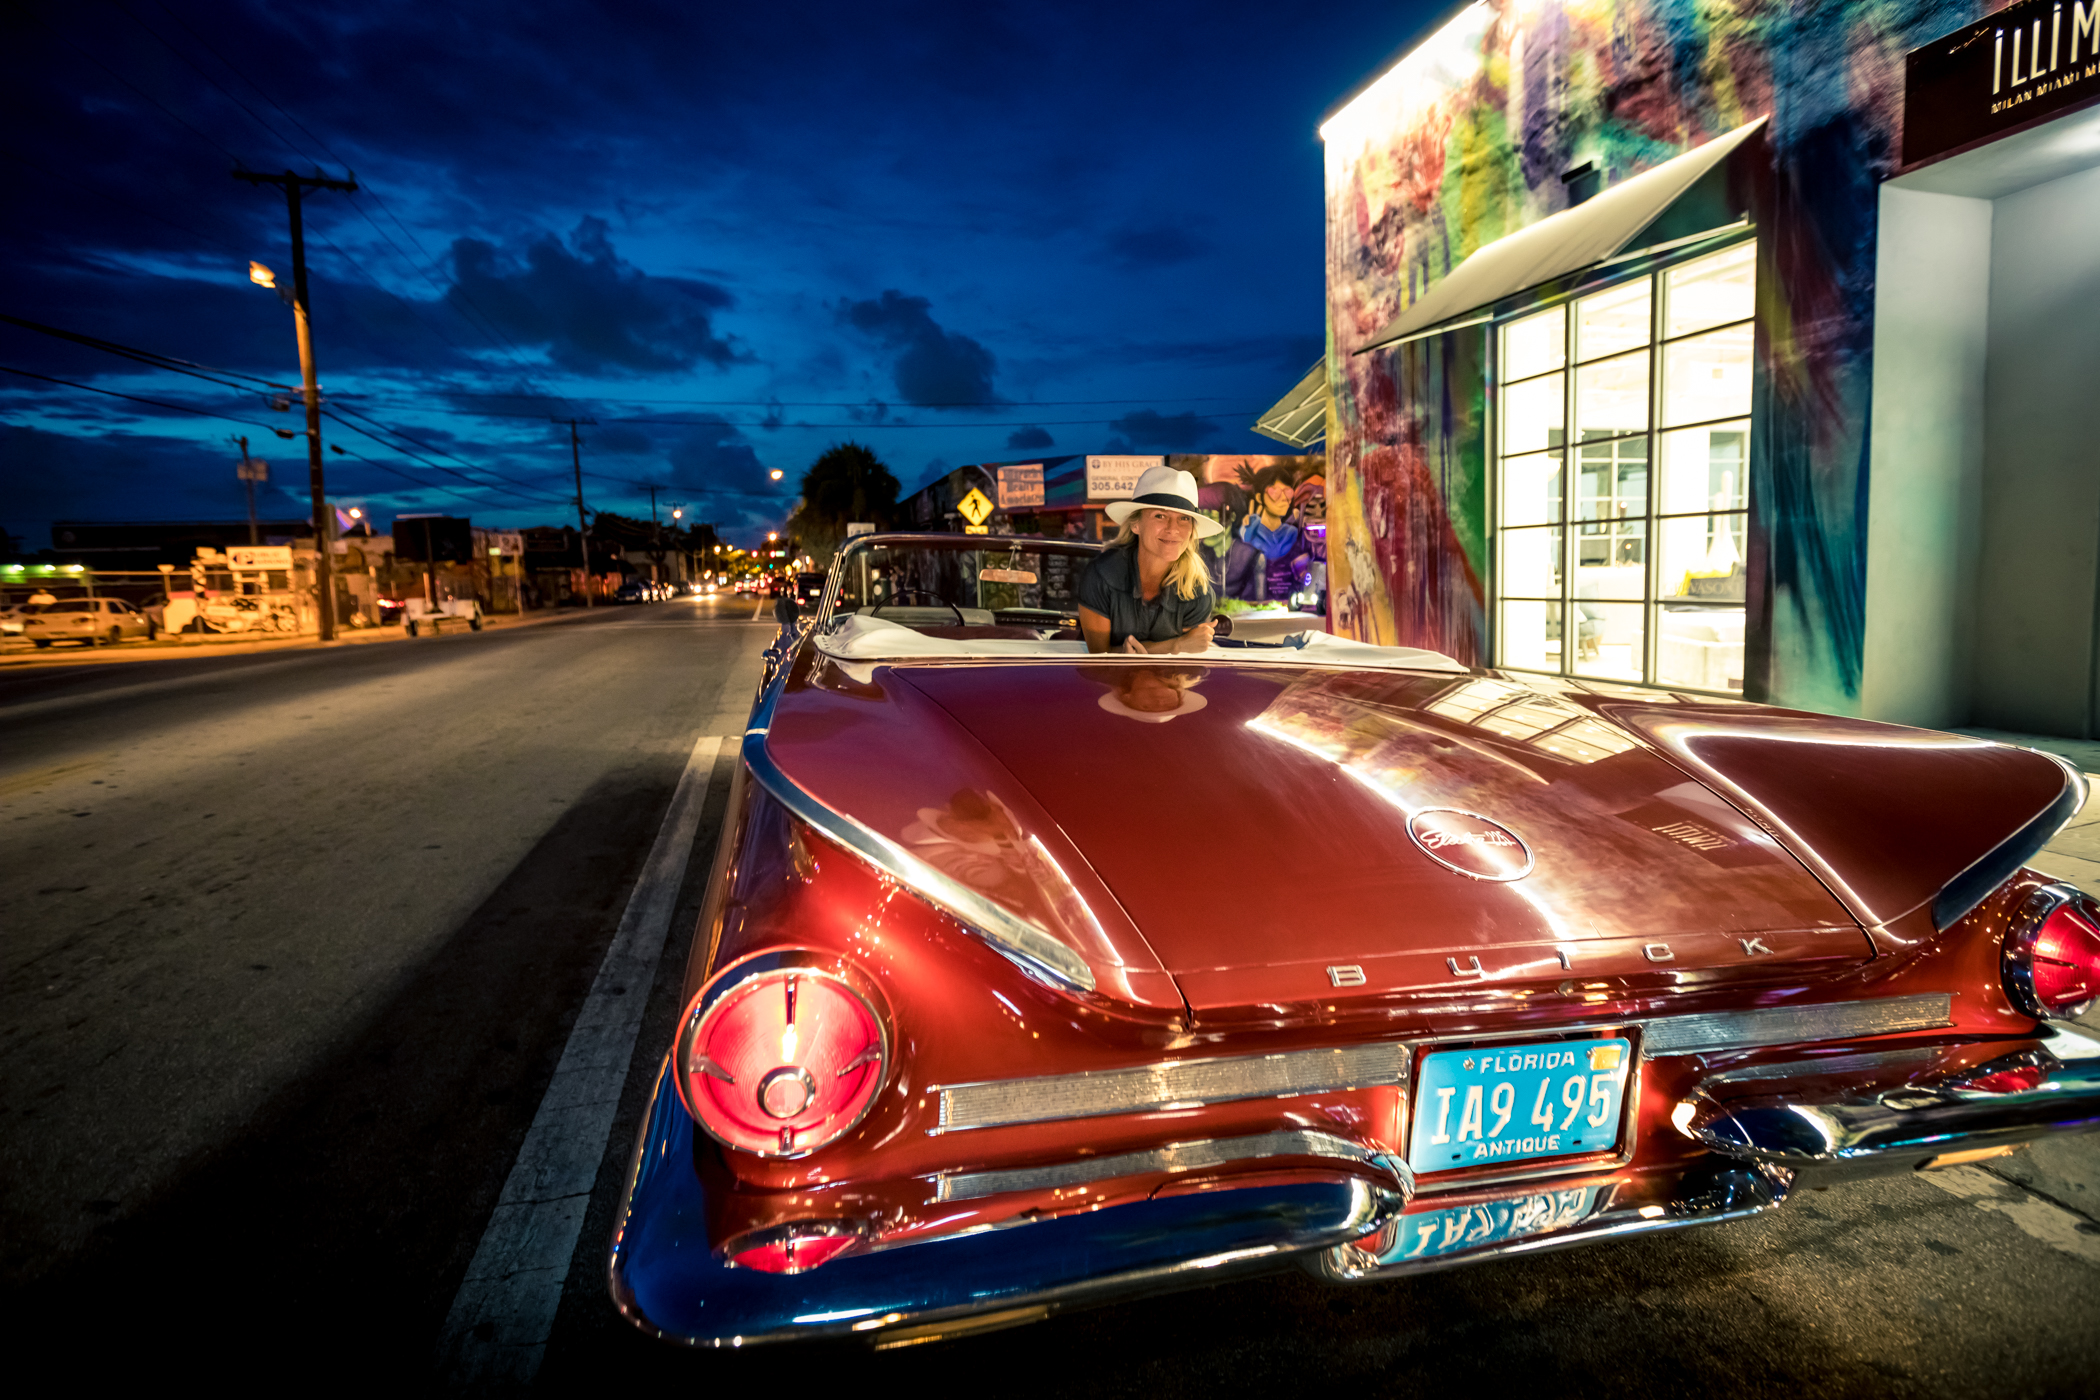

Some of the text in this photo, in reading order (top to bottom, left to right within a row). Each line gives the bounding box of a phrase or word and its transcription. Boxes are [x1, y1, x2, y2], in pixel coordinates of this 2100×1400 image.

[1990, 90, 2032, 114] MILAN
[2036, 71, 2080, 97] MIAMI
[1326, 936, 1775, 988] BUICK
[1480, 1051, 1576, 1074] FLORIDA
[1431, 1073, 1613, 1145] IA9 495
[1473, 1134, 1561, 1159] ANTIQUE
